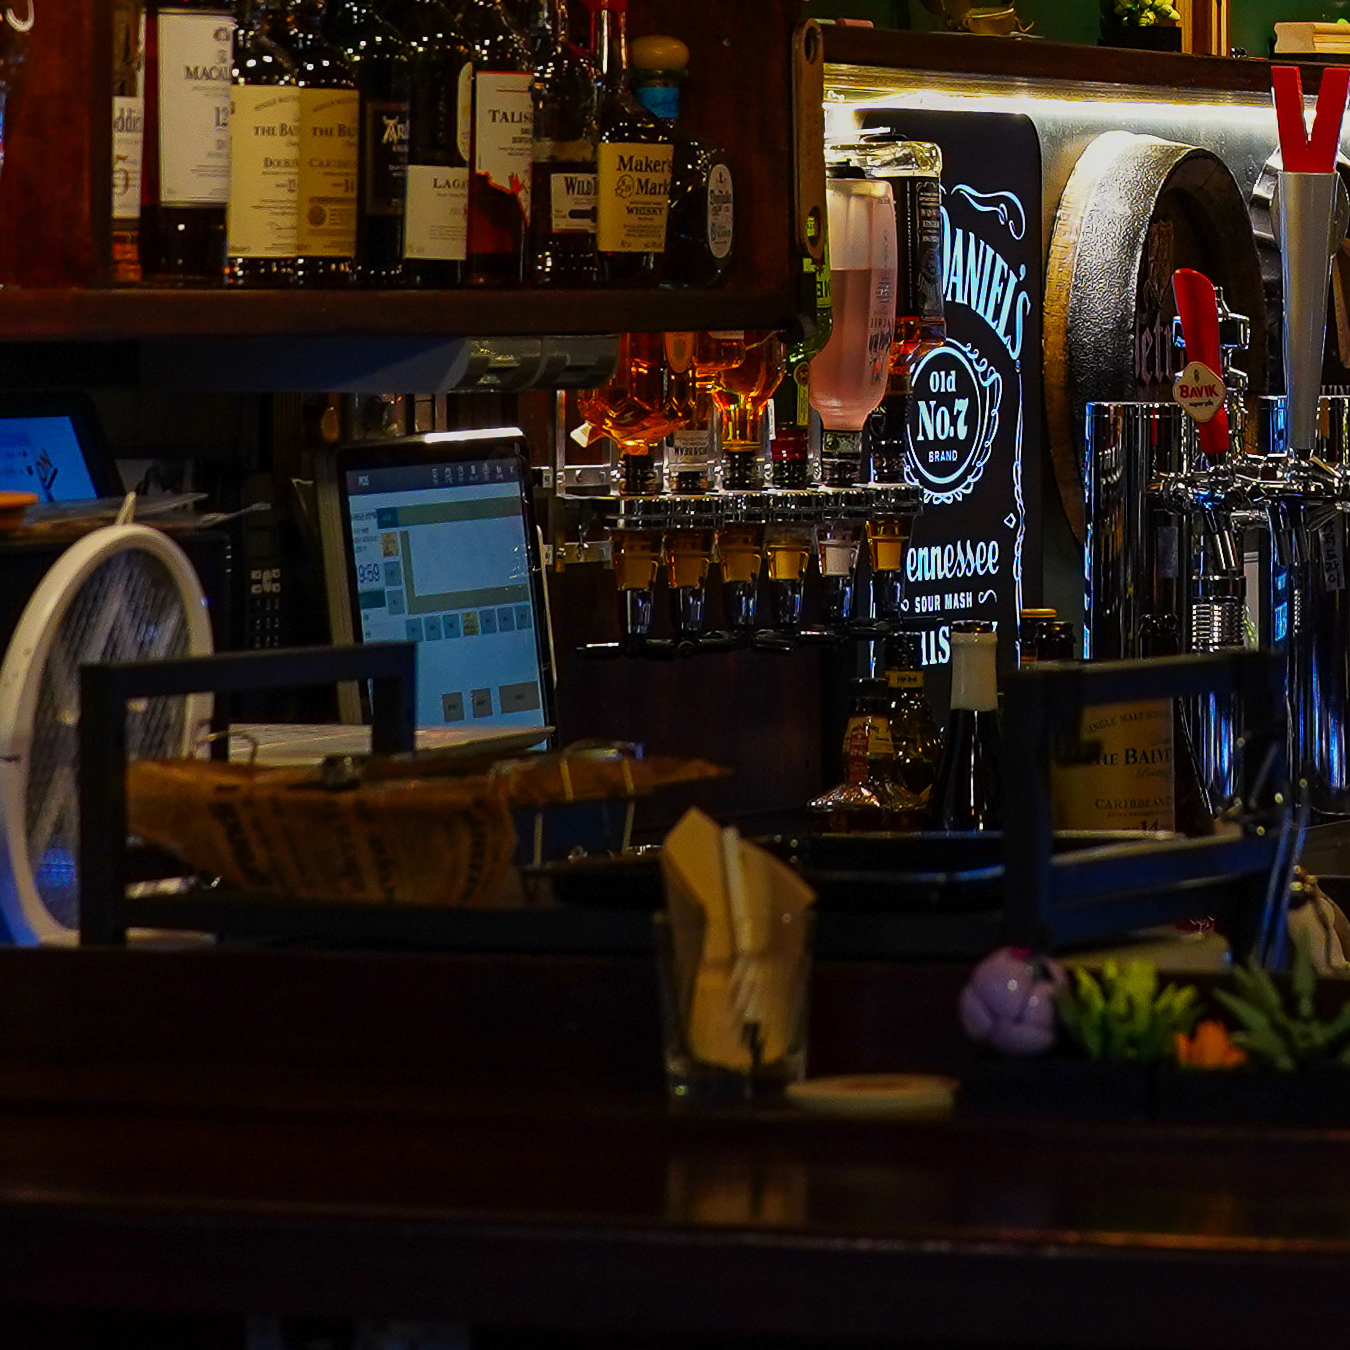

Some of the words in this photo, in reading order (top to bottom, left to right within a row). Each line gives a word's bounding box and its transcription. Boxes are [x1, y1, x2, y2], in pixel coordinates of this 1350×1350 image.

[930, 370, 956, 393] Old
[1179, 385, 1219, 399] BAVIK
[917, 398, 969, 441] No.7
[929, 450, 958, 463] BRAND
[914, 594, 941, 613] SOUR
[944, 591, 973, 610] MASH
